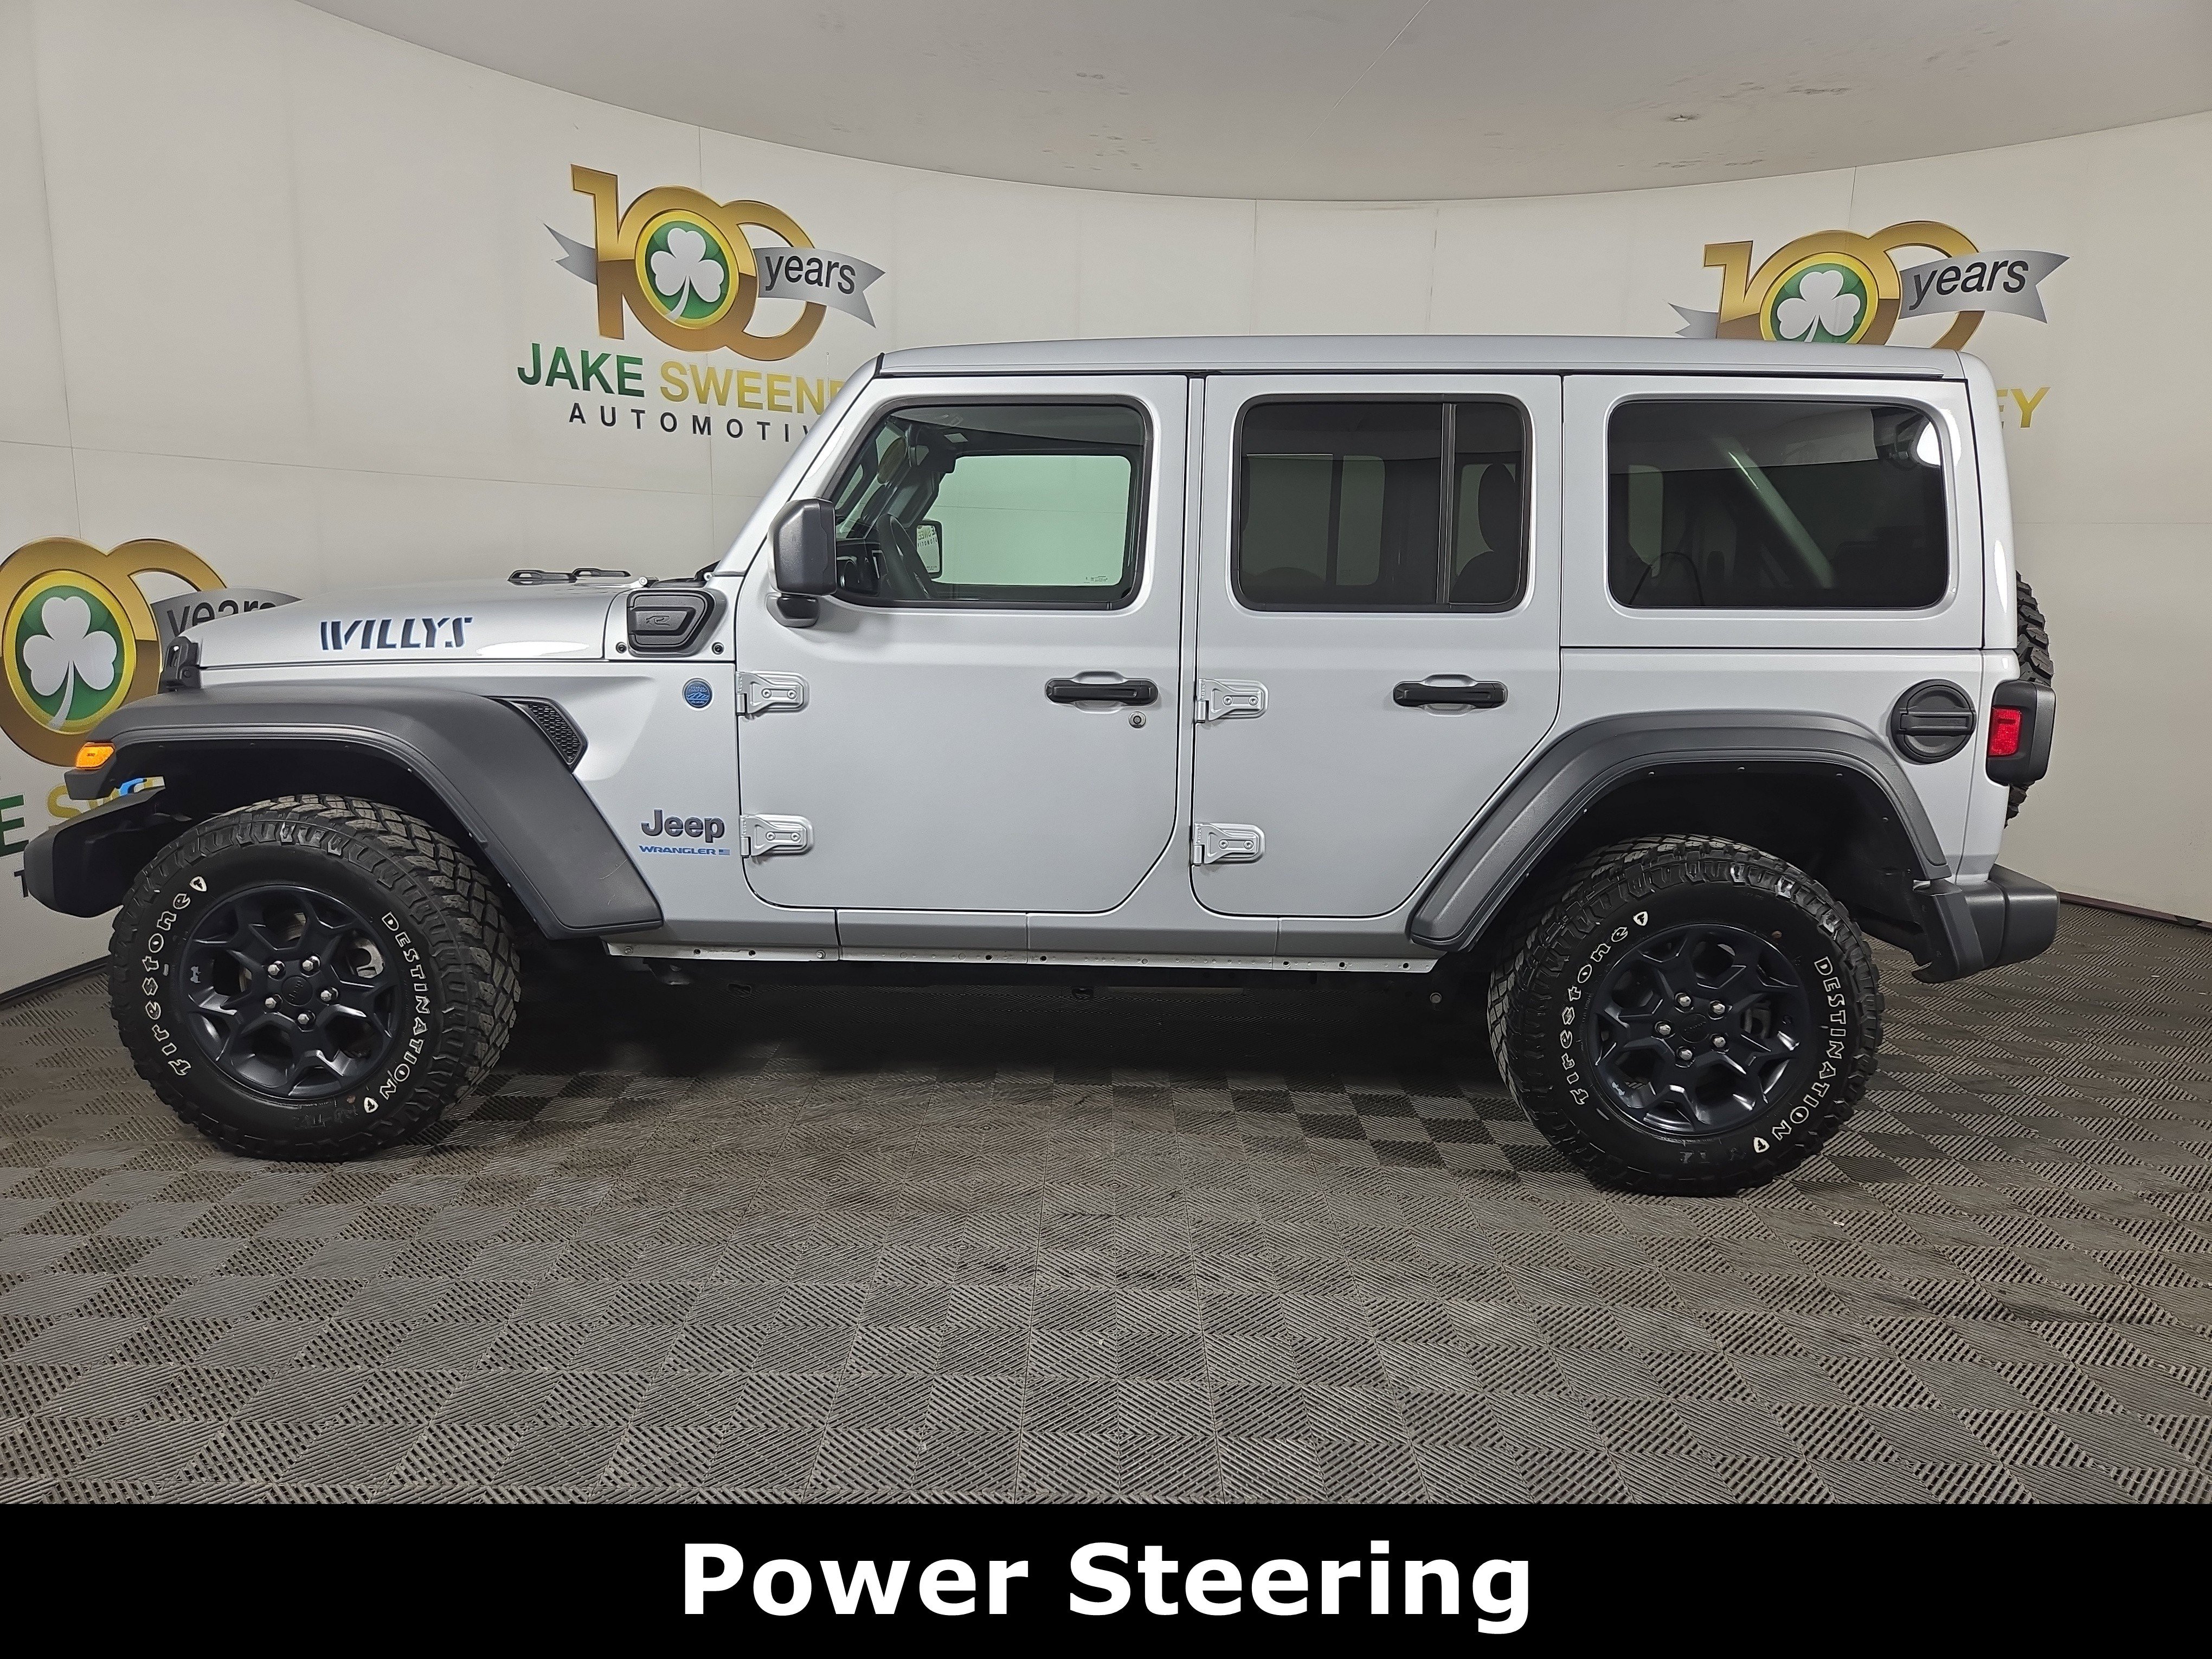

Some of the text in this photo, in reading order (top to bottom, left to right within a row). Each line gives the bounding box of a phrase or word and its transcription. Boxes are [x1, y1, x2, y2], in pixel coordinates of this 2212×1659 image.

[571, 164, 856, 361] 100 years
[1908, 259, 2029, 311] years
[518, 343, 645, 398] JAKE
[569, 402, 809, 442] AUTOMOTI
[320, 617, 473, 651] WILLYS
[639, 845, 717, 856] WRANGLER
[641, 809, 725, 844] Jeep
[142, 892, 191, 1076] Firestone
[379, 911, 432, 1101] DESTINATION
[1560, 927, 1628, 1105] Firestone
[1772, 956, 1847, 1141] DESTINATION
